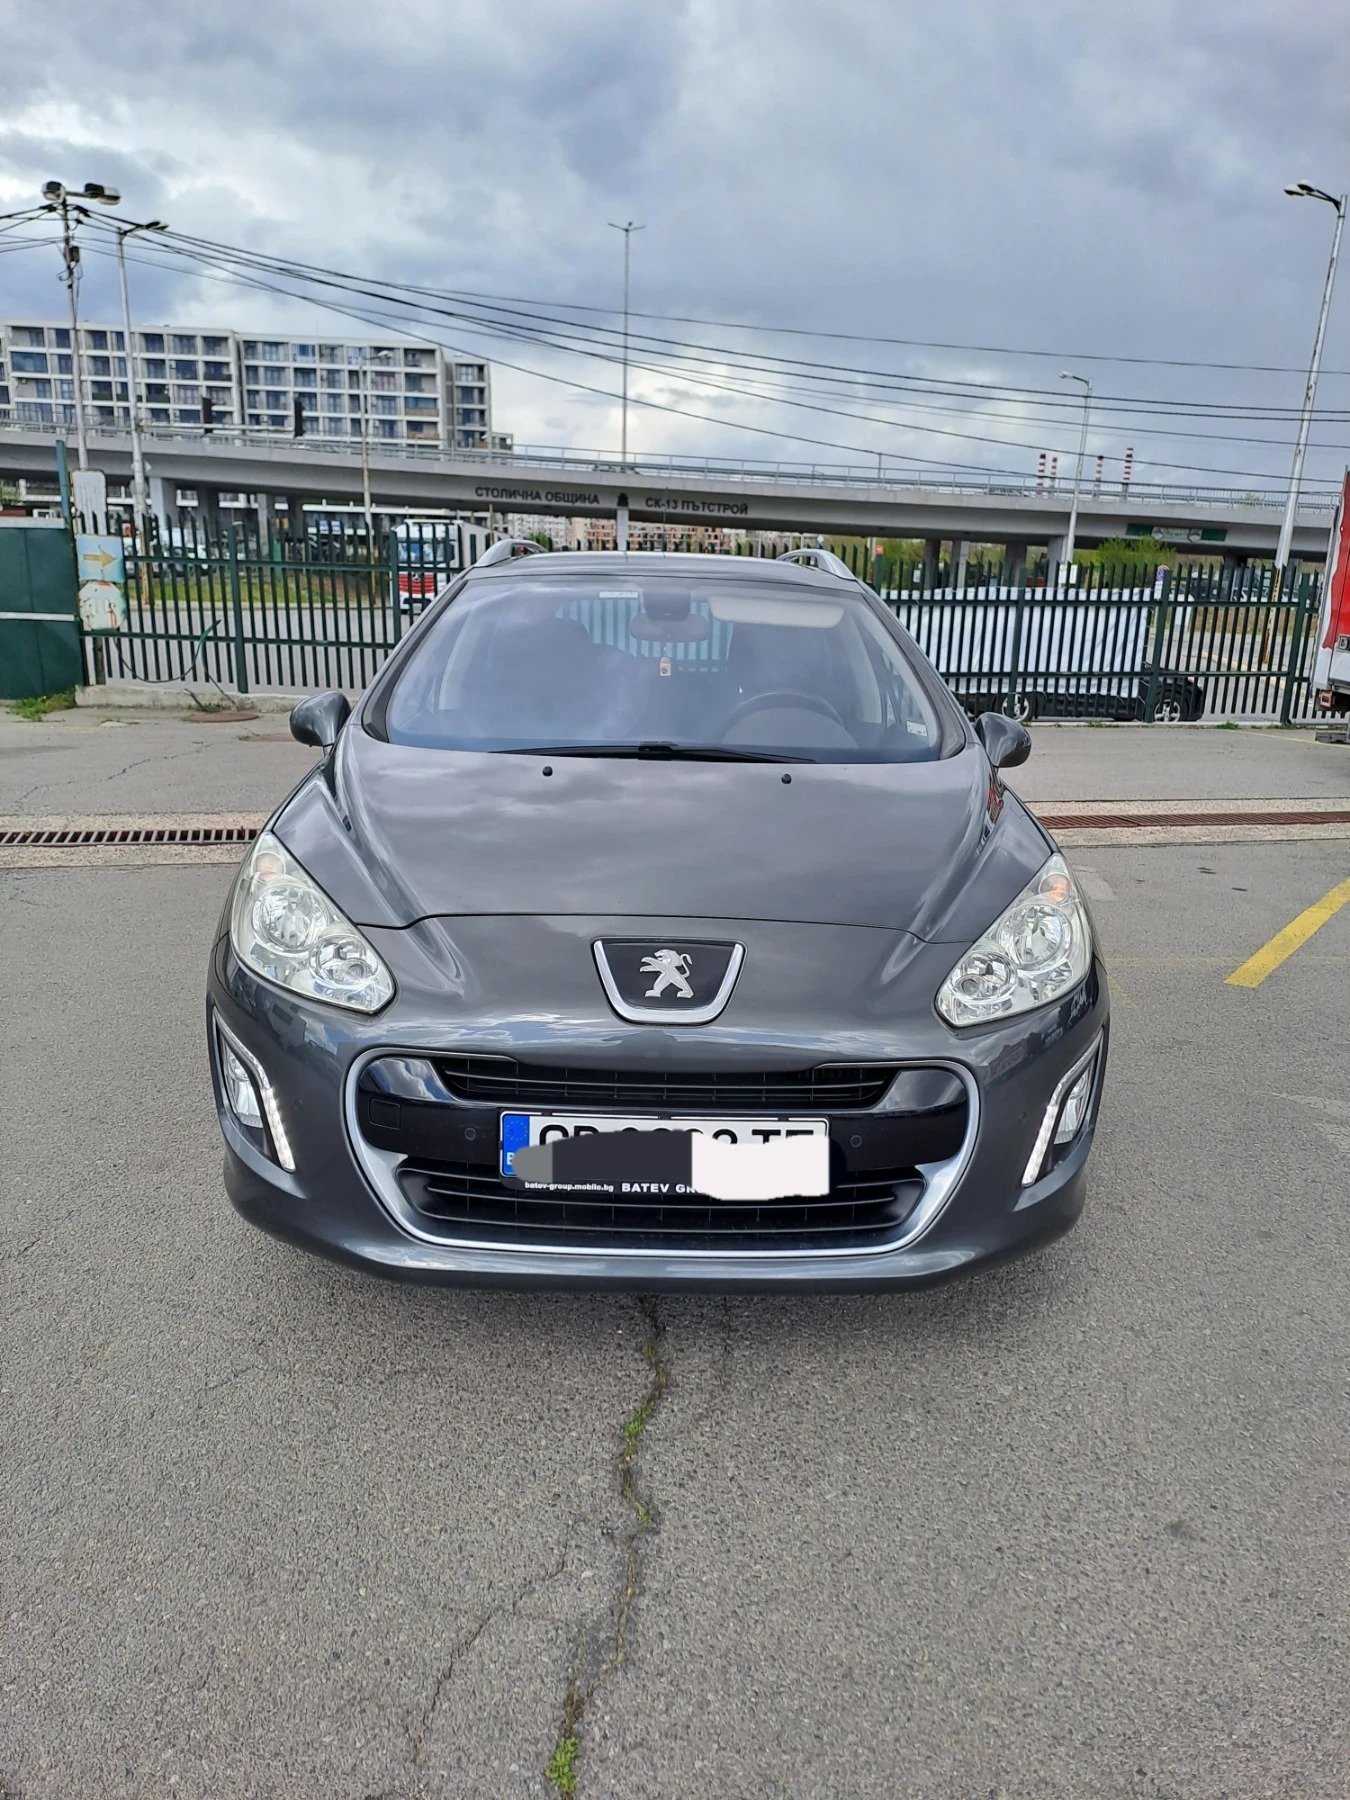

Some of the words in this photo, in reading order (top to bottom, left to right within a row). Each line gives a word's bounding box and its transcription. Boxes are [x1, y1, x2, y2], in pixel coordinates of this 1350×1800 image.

[475, 486, 542, 501] СТОЛИЧНА
[545, 491, 600, 505] ОБЩИНА
[645, 497, 678, 510] СК-13
[681, 500, 748, 516] ПЪТСТРОЙ
[524, 1181, 614, 1193] batev-group.mobile.bg
[621, 1182, 670, 1194] BATEV
